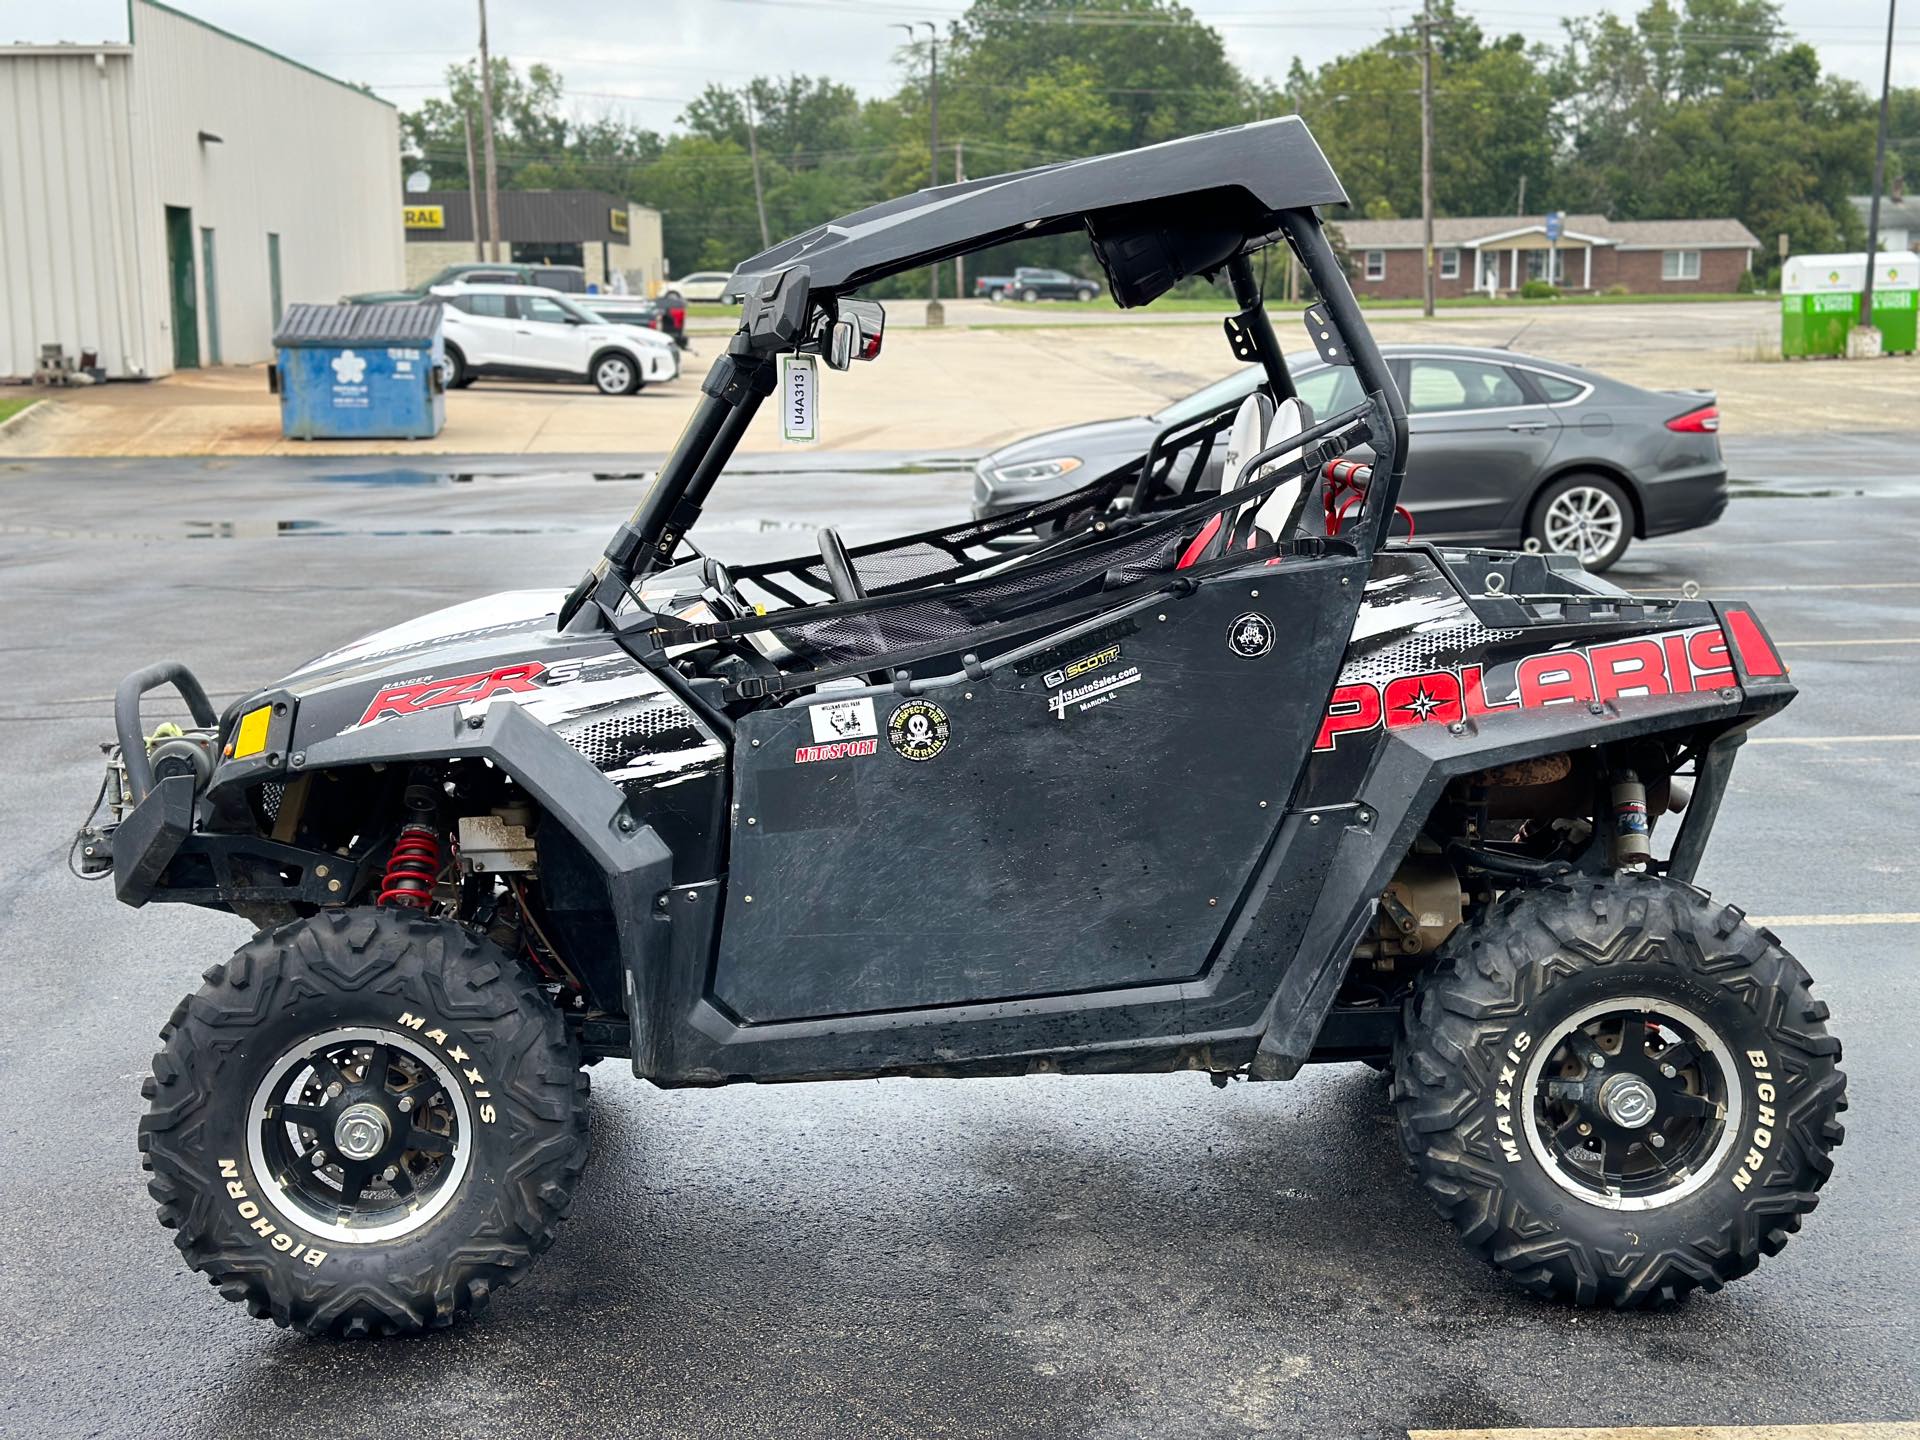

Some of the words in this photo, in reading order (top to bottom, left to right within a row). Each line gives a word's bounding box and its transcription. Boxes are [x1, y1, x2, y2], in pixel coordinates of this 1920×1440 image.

[794, 374, 805, 425] U4A313
[432, 619, 548, 644] OUTPUT
[382, 674, 434, 690] RANGER
[1066, 646, 1120, 680] SCOTT
[1312, 624, 1737, 752] POLARIS
[358, 661, 548, 727] RZR
[547, 661, 584, 684] S
[894, 706, 926, 728] RESPECT
[928, 708, 942, 723] THE
[902, 740, 942, 757] TERRAIN
[397, 1012, 496, 1123] MAXXIS
[1494, 1031, 1531, 1162] MAXXIS
[1731, 1050, 1776, 1192] BIGHORN
[218, 1160, 328, 1267] BIGHORN
